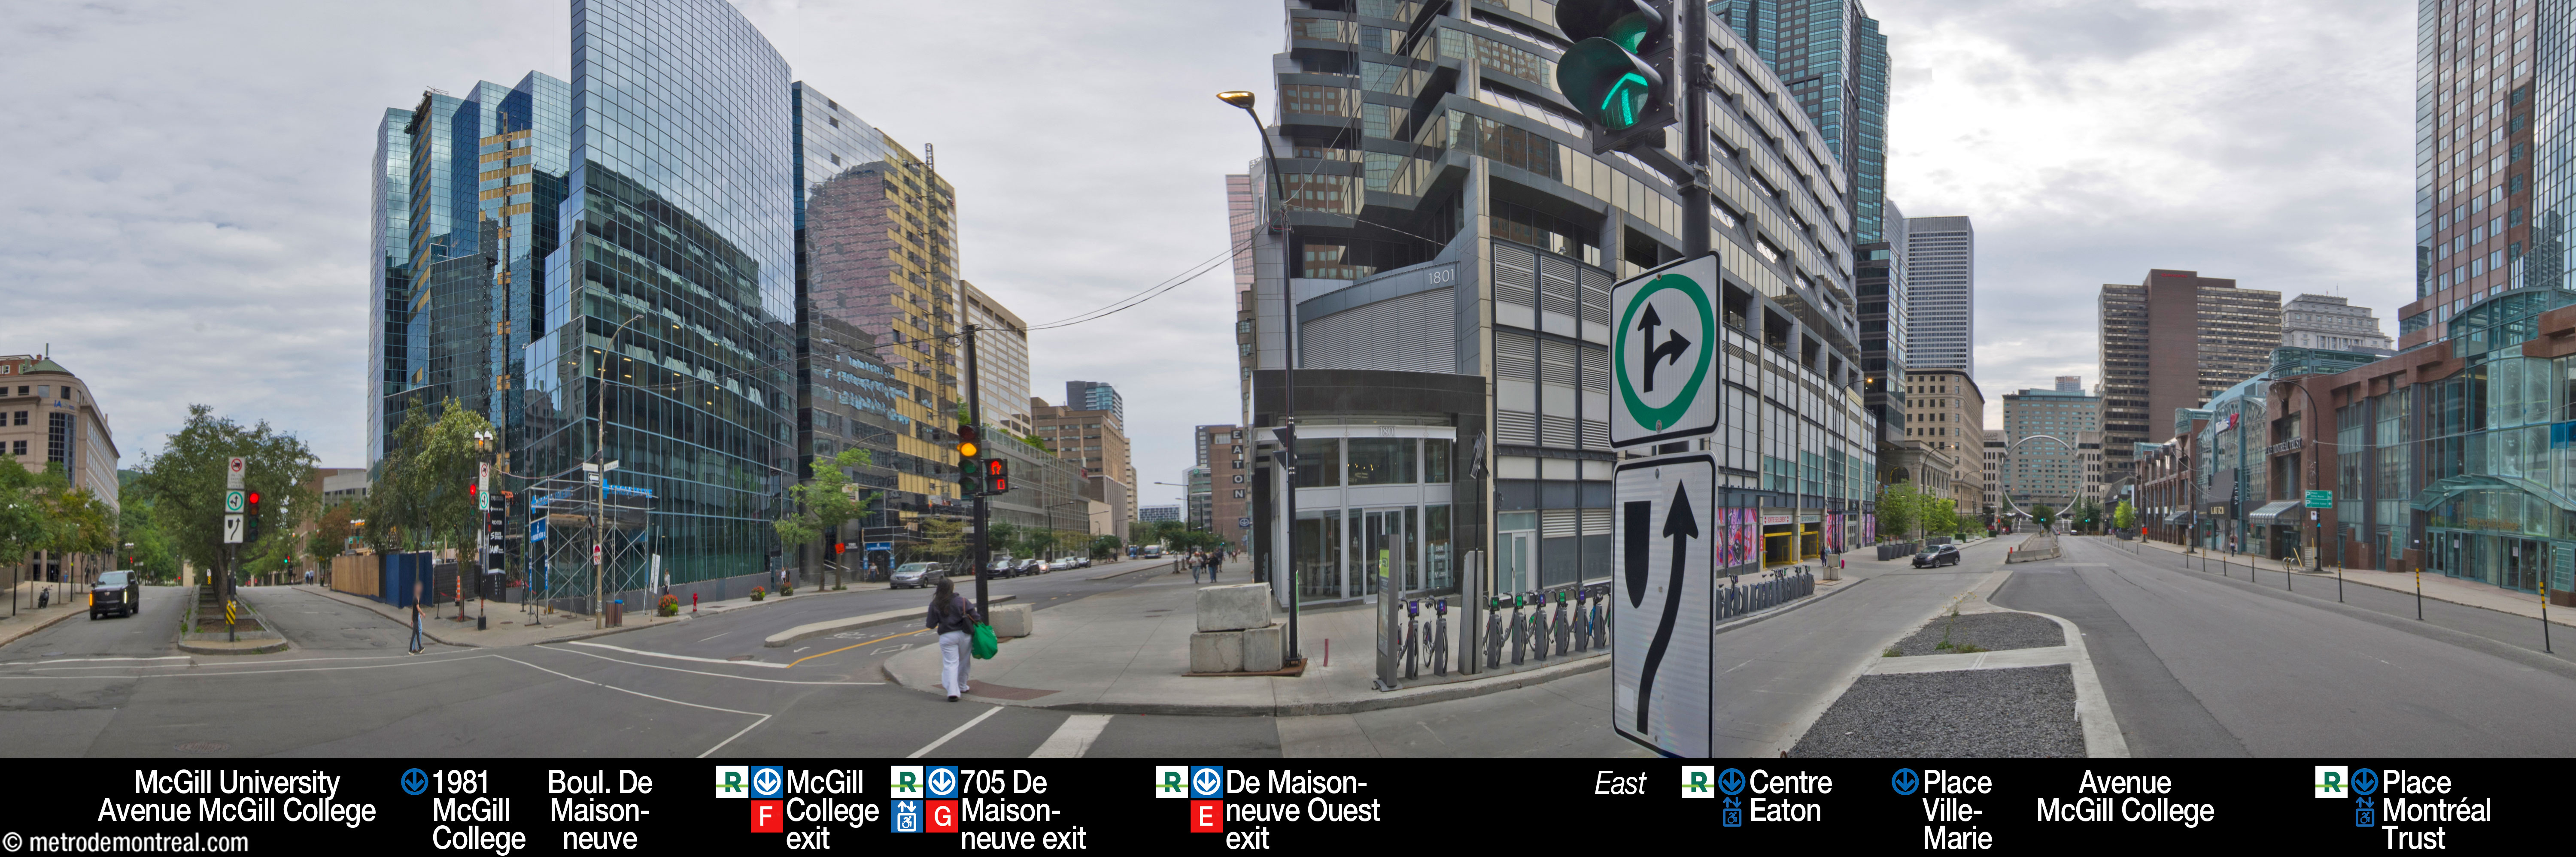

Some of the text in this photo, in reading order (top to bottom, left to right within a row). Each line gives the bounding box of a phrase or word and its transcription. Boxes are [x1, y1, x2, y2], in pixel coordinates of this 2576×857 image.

[1429, 269, 1454, 285] 1801
[1379, 426, 1397, 436] 1801
[2289, 437, 2302, 450] TRUST
[1233, 430, 1244, 498] EATON
